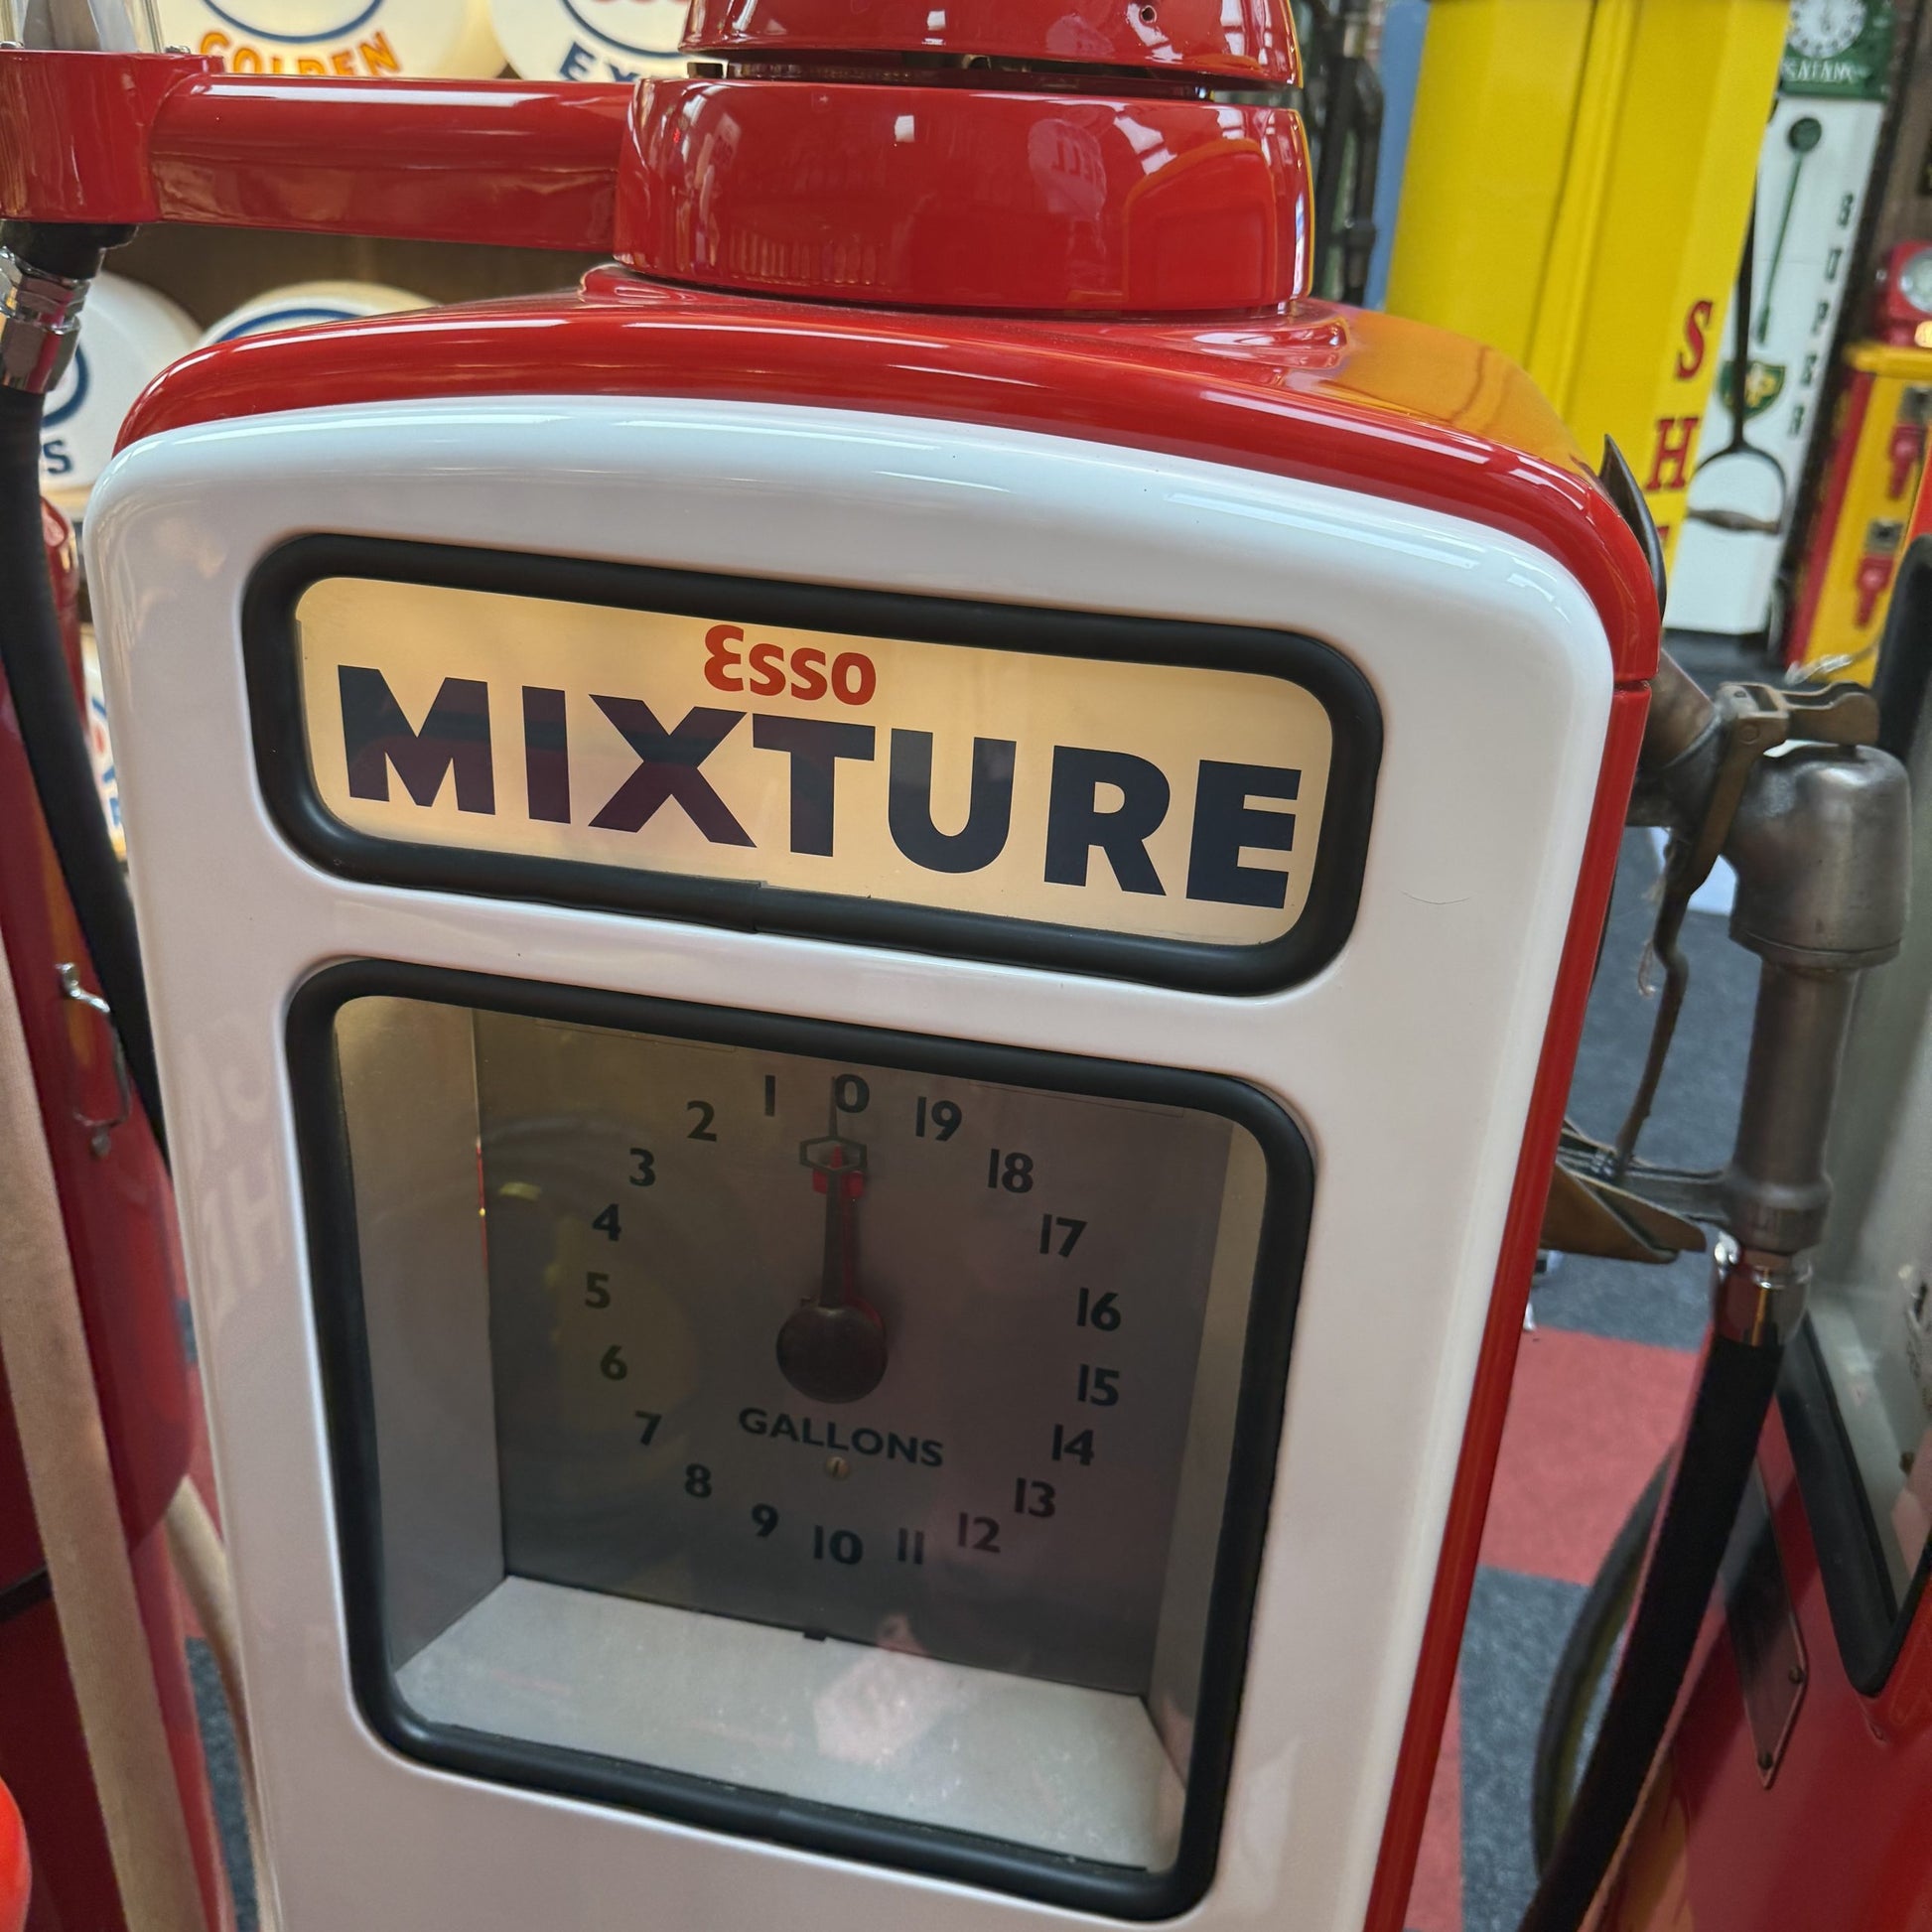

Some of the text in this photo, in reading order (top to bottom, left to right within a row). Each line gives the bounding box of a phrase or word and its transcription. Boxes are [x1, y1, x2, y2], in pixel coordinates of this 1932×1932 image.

[1634, 300, 1713, 544] SH
[338, 664, 1302, 909] MIXTURE
[764, 1074, 776, 1117] 1
[835, 1073, 870, 1113] 0
[687, 1100, 718, 1142] 2
[915, 1096, 962, 1142] 19
[629, 1148, 656, 1187] 3
[987, 1148, 1035, 1193] 18
[592, 1203, 622, 1242] 4
[1038, 1213, 1088, 1258] 17
[584, 1272, 612, 1310] 5
[1076, 1287, 1122, 1332] 16
[600, 1344, 628, 1381] 6
[1077, 1363, 1120, 1407] 15
[634, 1410, 662, 1447] 7
[739, 1406, 943, 1467] GALLONS
[1051, 1423, 1095, 1466] 14
[684, 1463, 713, 1499] 8
[1014, 1476, 1056, 1519] 13
[751, 1503, 779, 1538] 9
[958, 1511, 1001, 1554] 12
[813, 1525, 864, 1566] 10
[896, 1527, 924, 1568] 11
